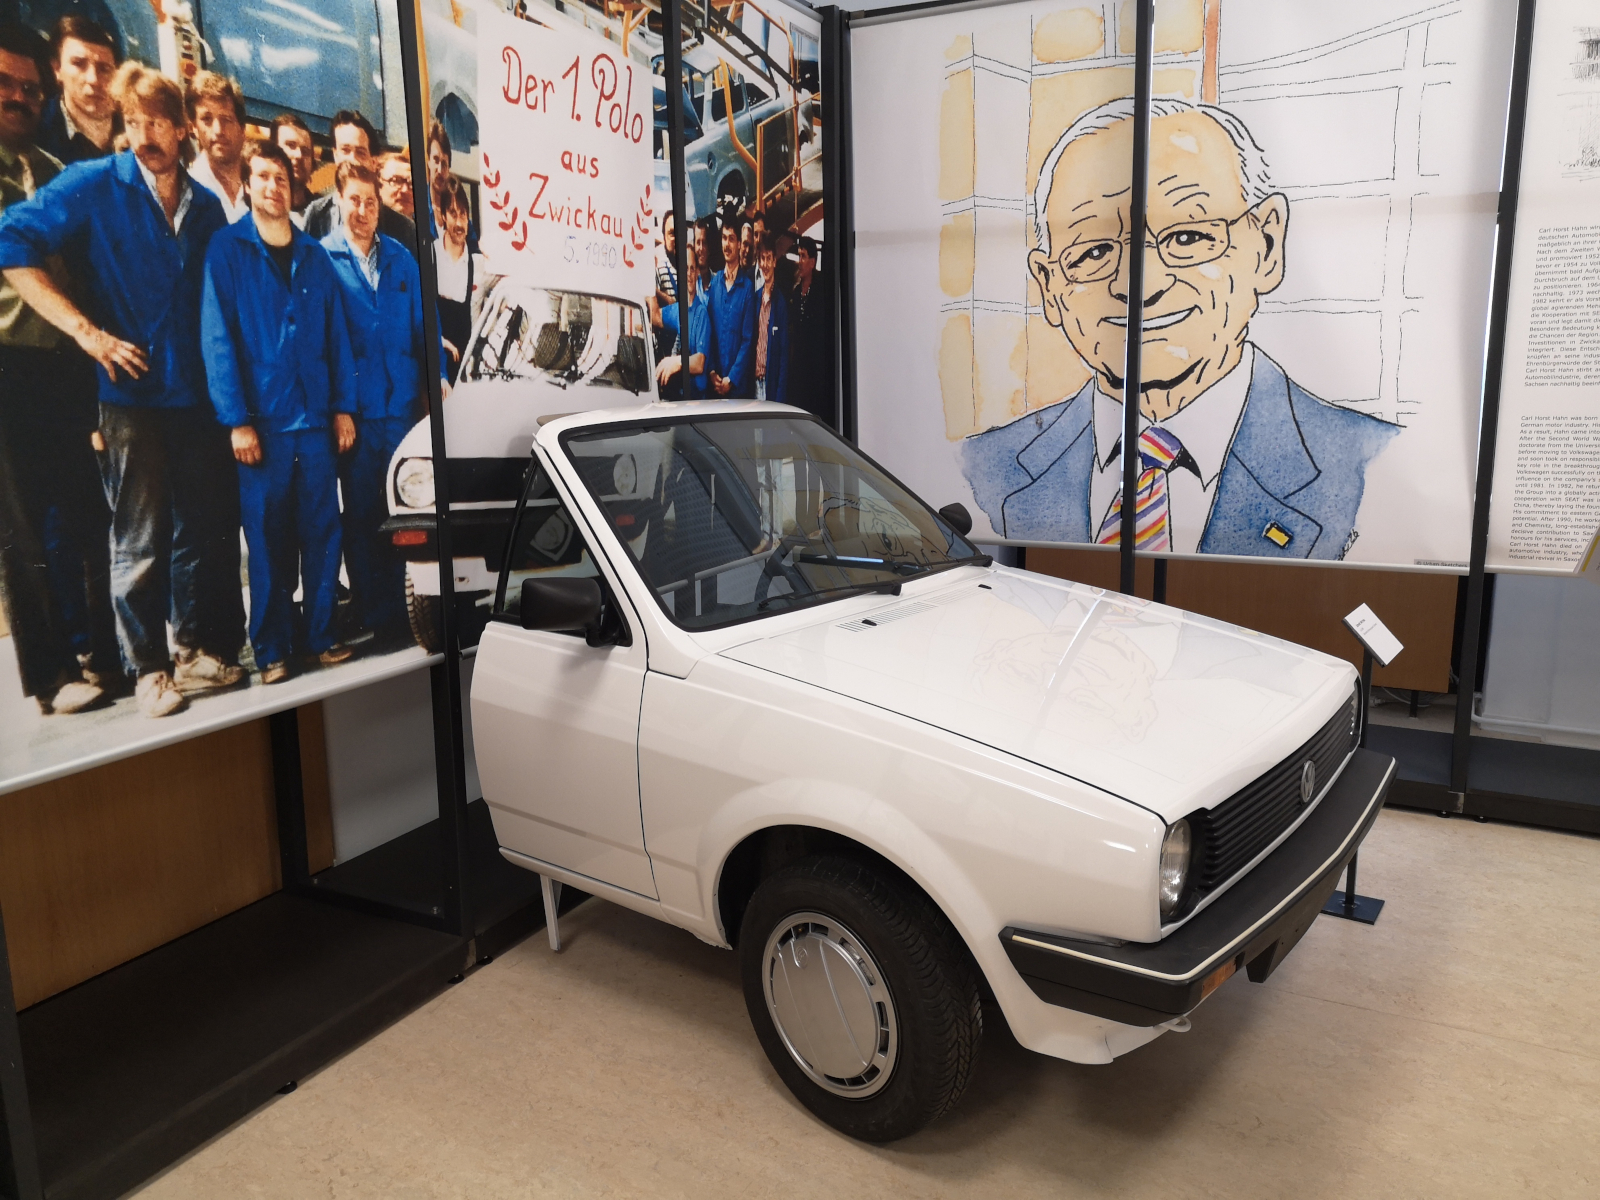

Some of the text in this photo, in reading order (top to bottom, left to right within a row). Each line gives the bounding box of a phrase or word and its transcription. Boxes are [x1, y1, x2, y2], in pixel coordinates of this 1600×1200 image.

[502, 45, 643, 143] Der 1. Polo
[560, 150, 599, 178] aus
[528, 172, 623, 239] Zwickau
[1550, 254, 1583, 262] promoviert
[1542, 311, 1577, 319] Kooperation
